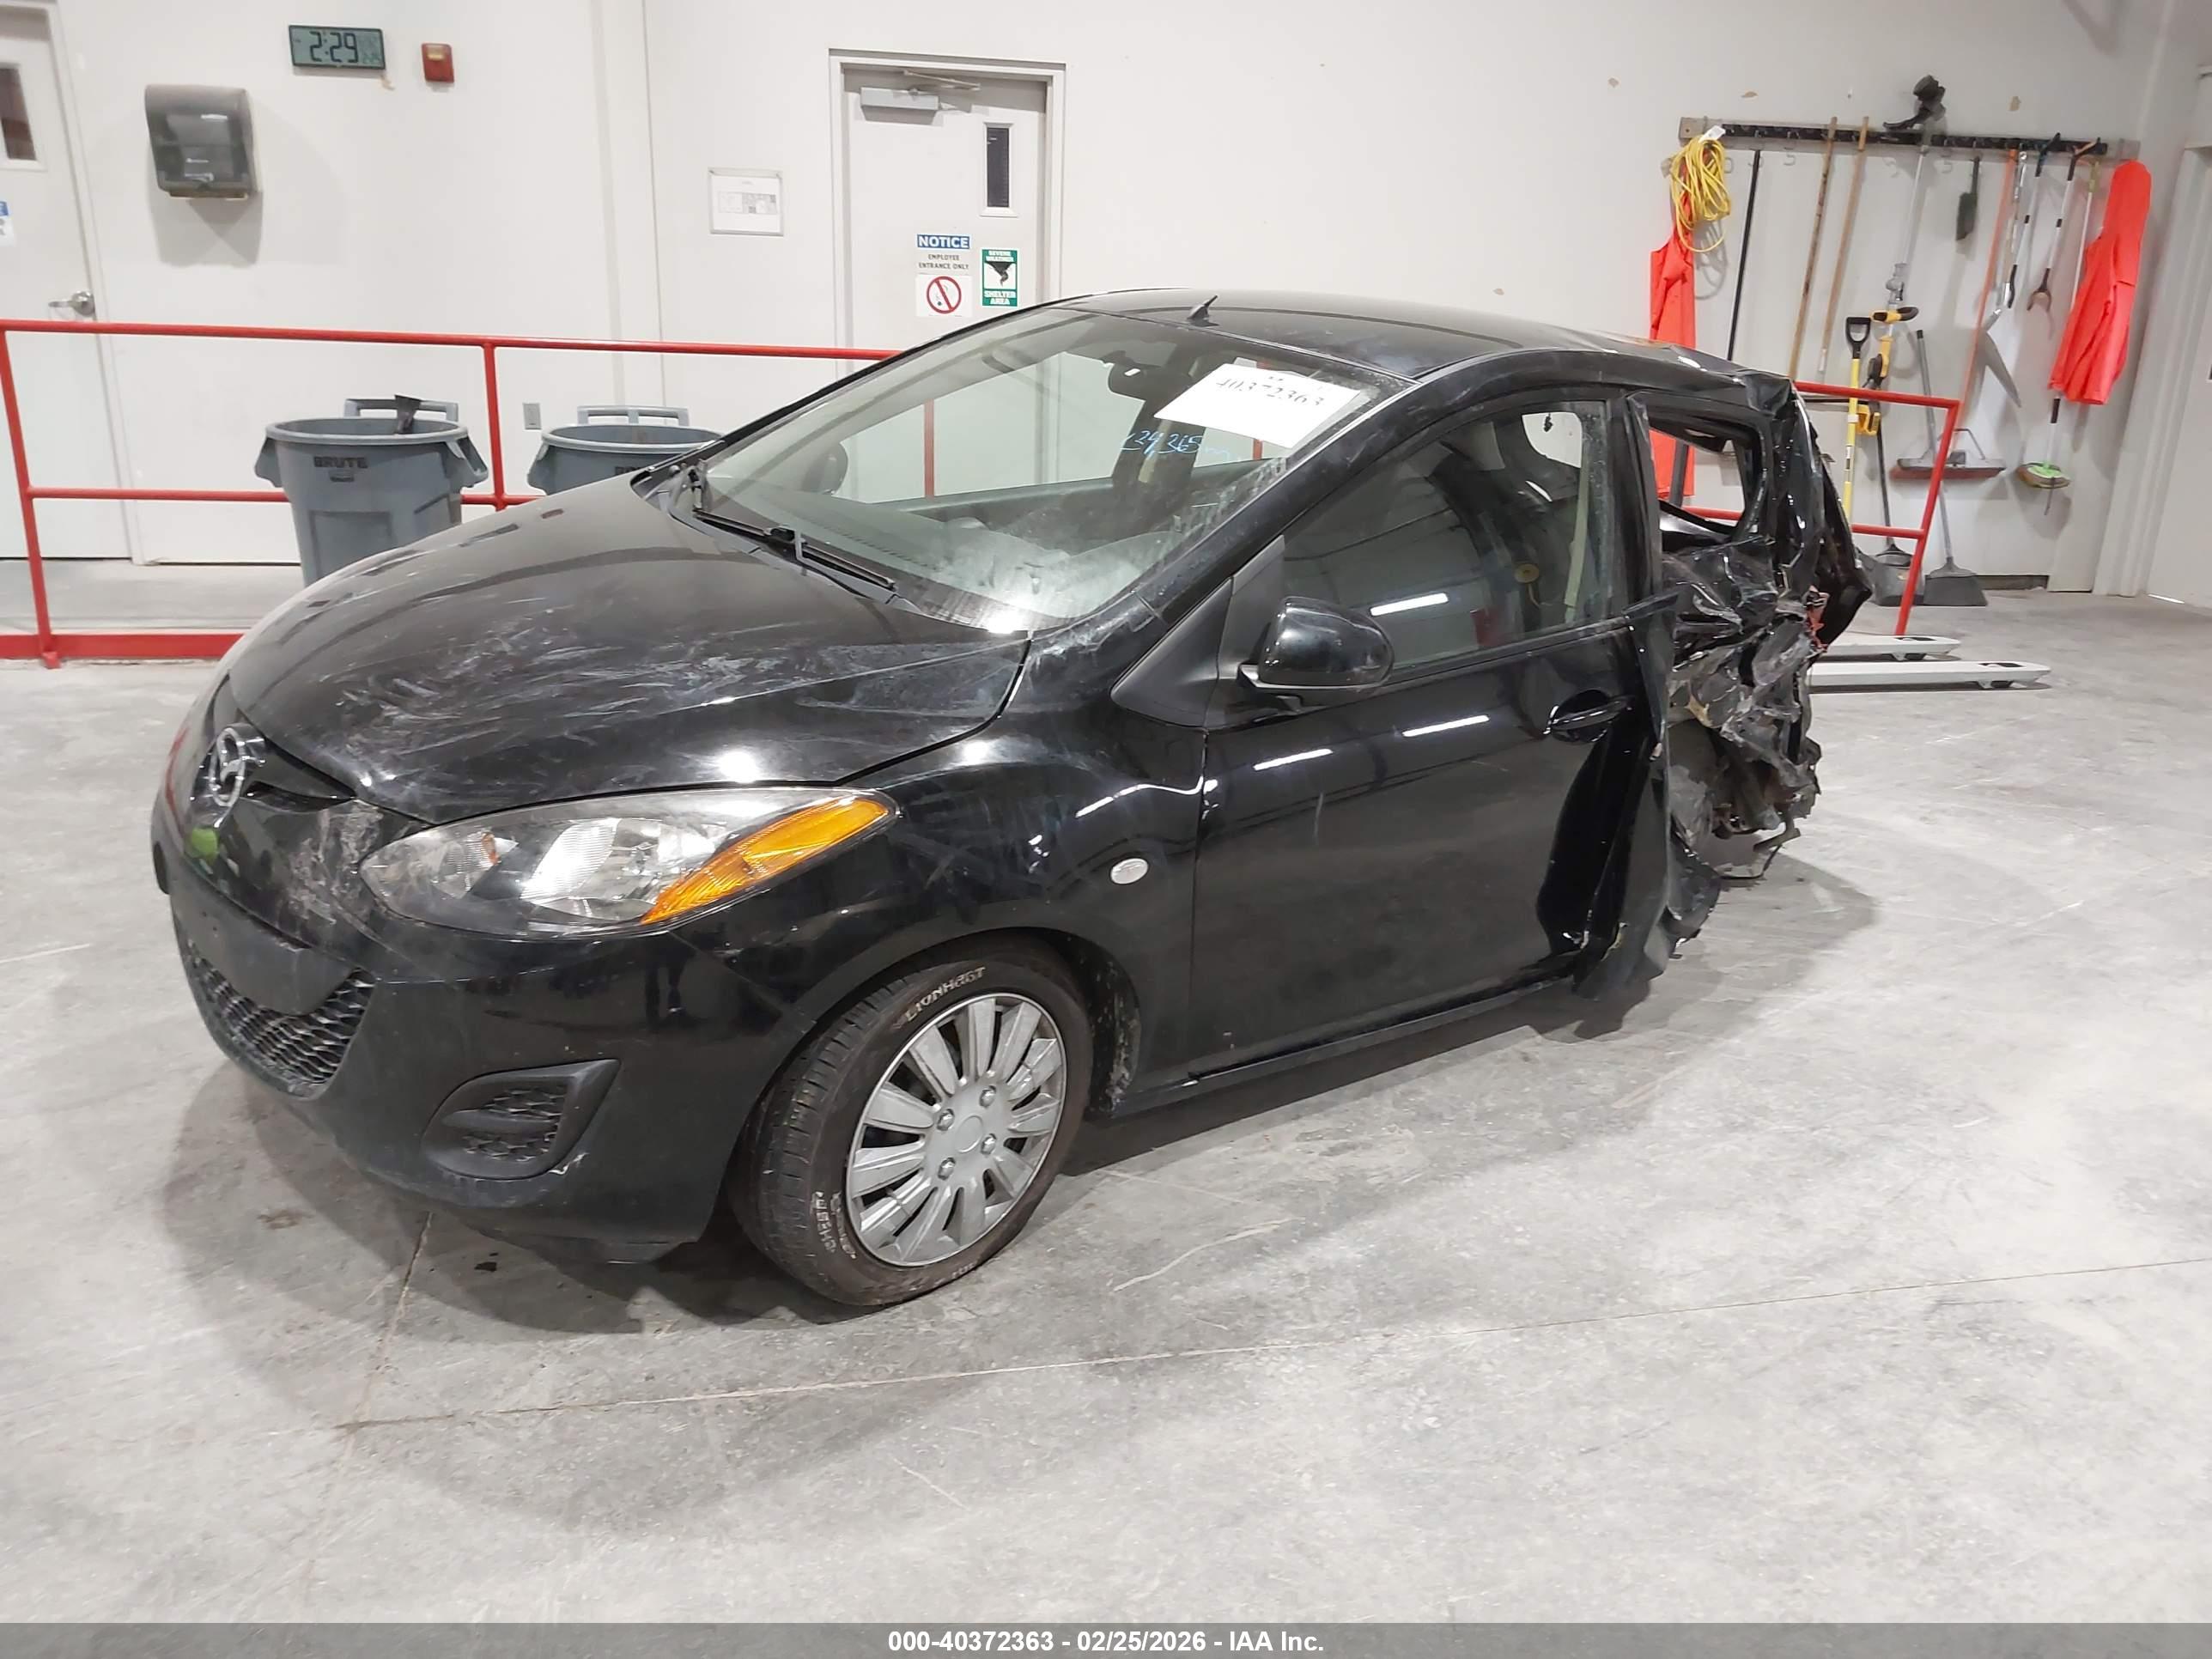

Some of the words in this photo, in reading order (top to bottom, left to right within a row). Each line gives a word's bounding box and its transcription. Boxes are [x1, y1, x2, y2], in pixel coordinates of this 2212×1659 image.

[309, 31, 359, 63] 2:29
[918, 235, 969, 248] NOTICE
[314, 456, 368, 469] BRUTE
